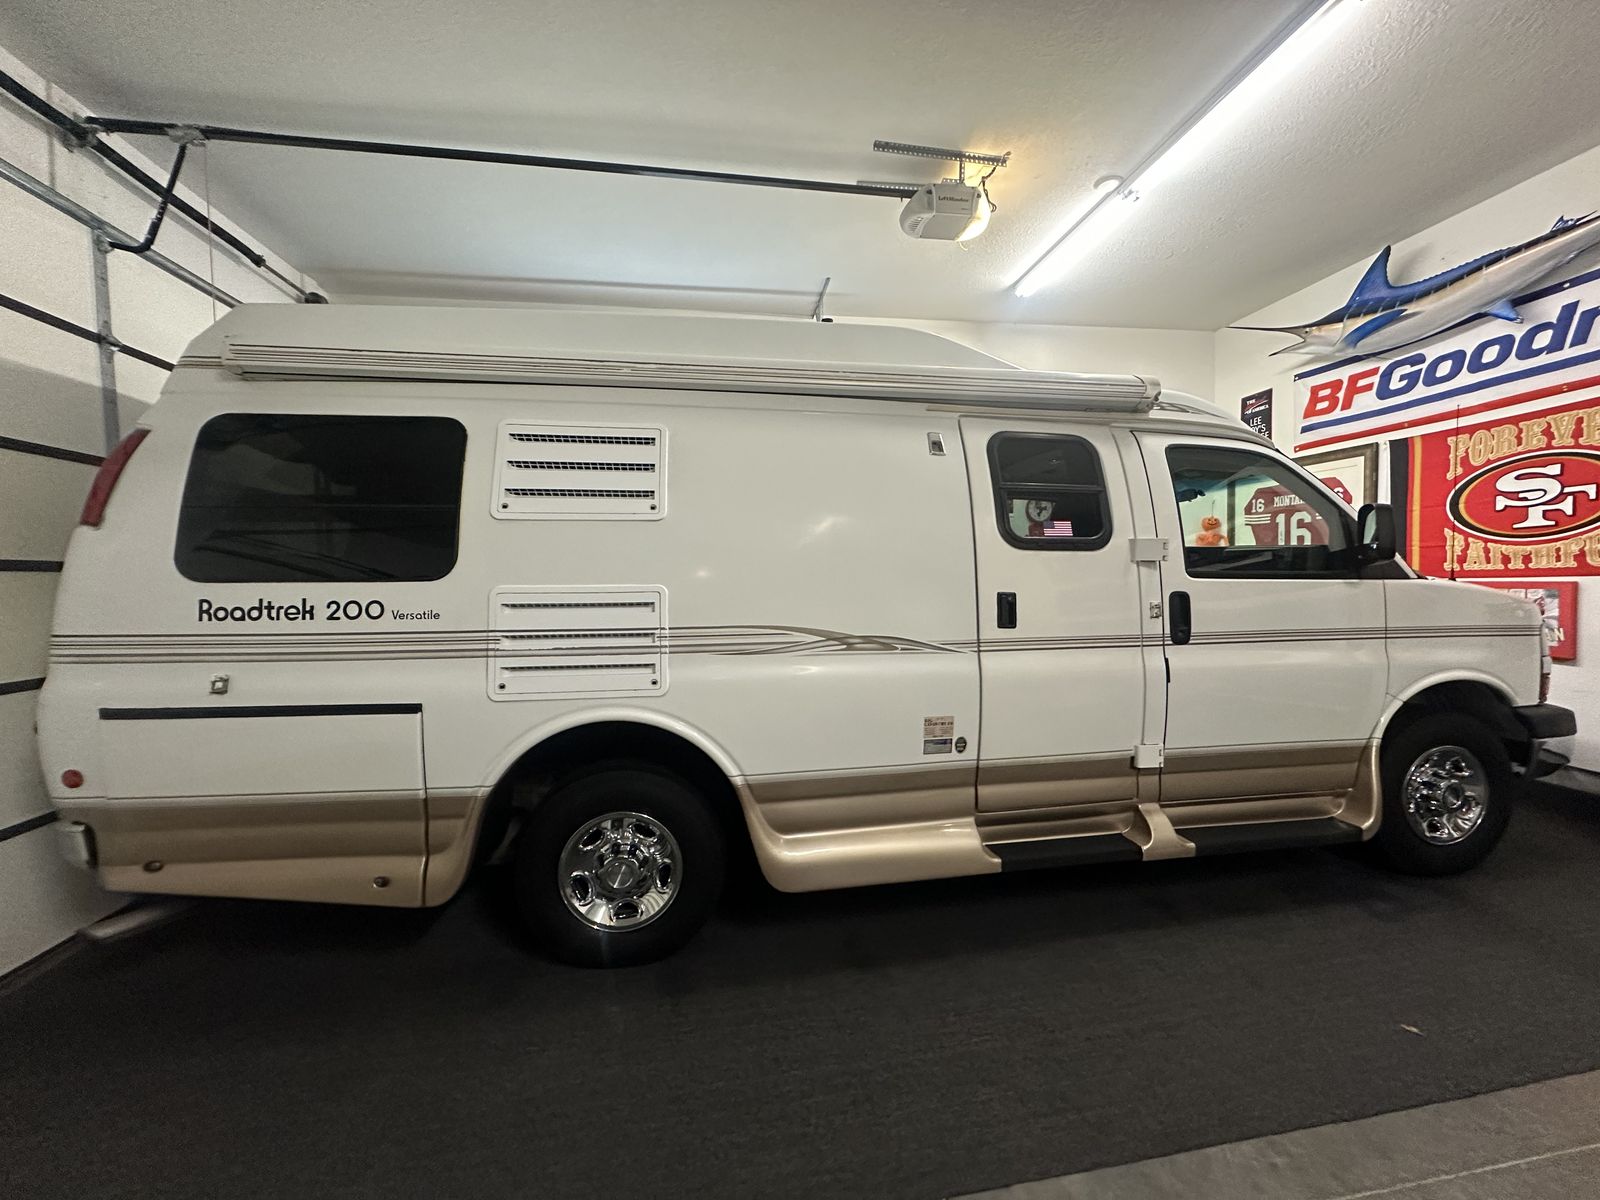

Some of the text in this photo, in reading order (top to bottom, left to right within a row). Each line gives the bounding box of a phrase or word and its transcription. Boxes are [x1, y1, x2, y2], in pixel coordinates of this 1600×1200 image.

[1303, 300, 1600, 420] BFGoodr
[1250, 416, 1262, 427] LEE
[1446, 405, 1600, 481] FOREVE
[1251, 494, 1305, 513] 16 MONTA
[1276, 511, 1312, 546] 16
[1443, 527, 1600, 572] FAITHFU
[197, 598, 441, 622] Roadtrek 200 Versatile
